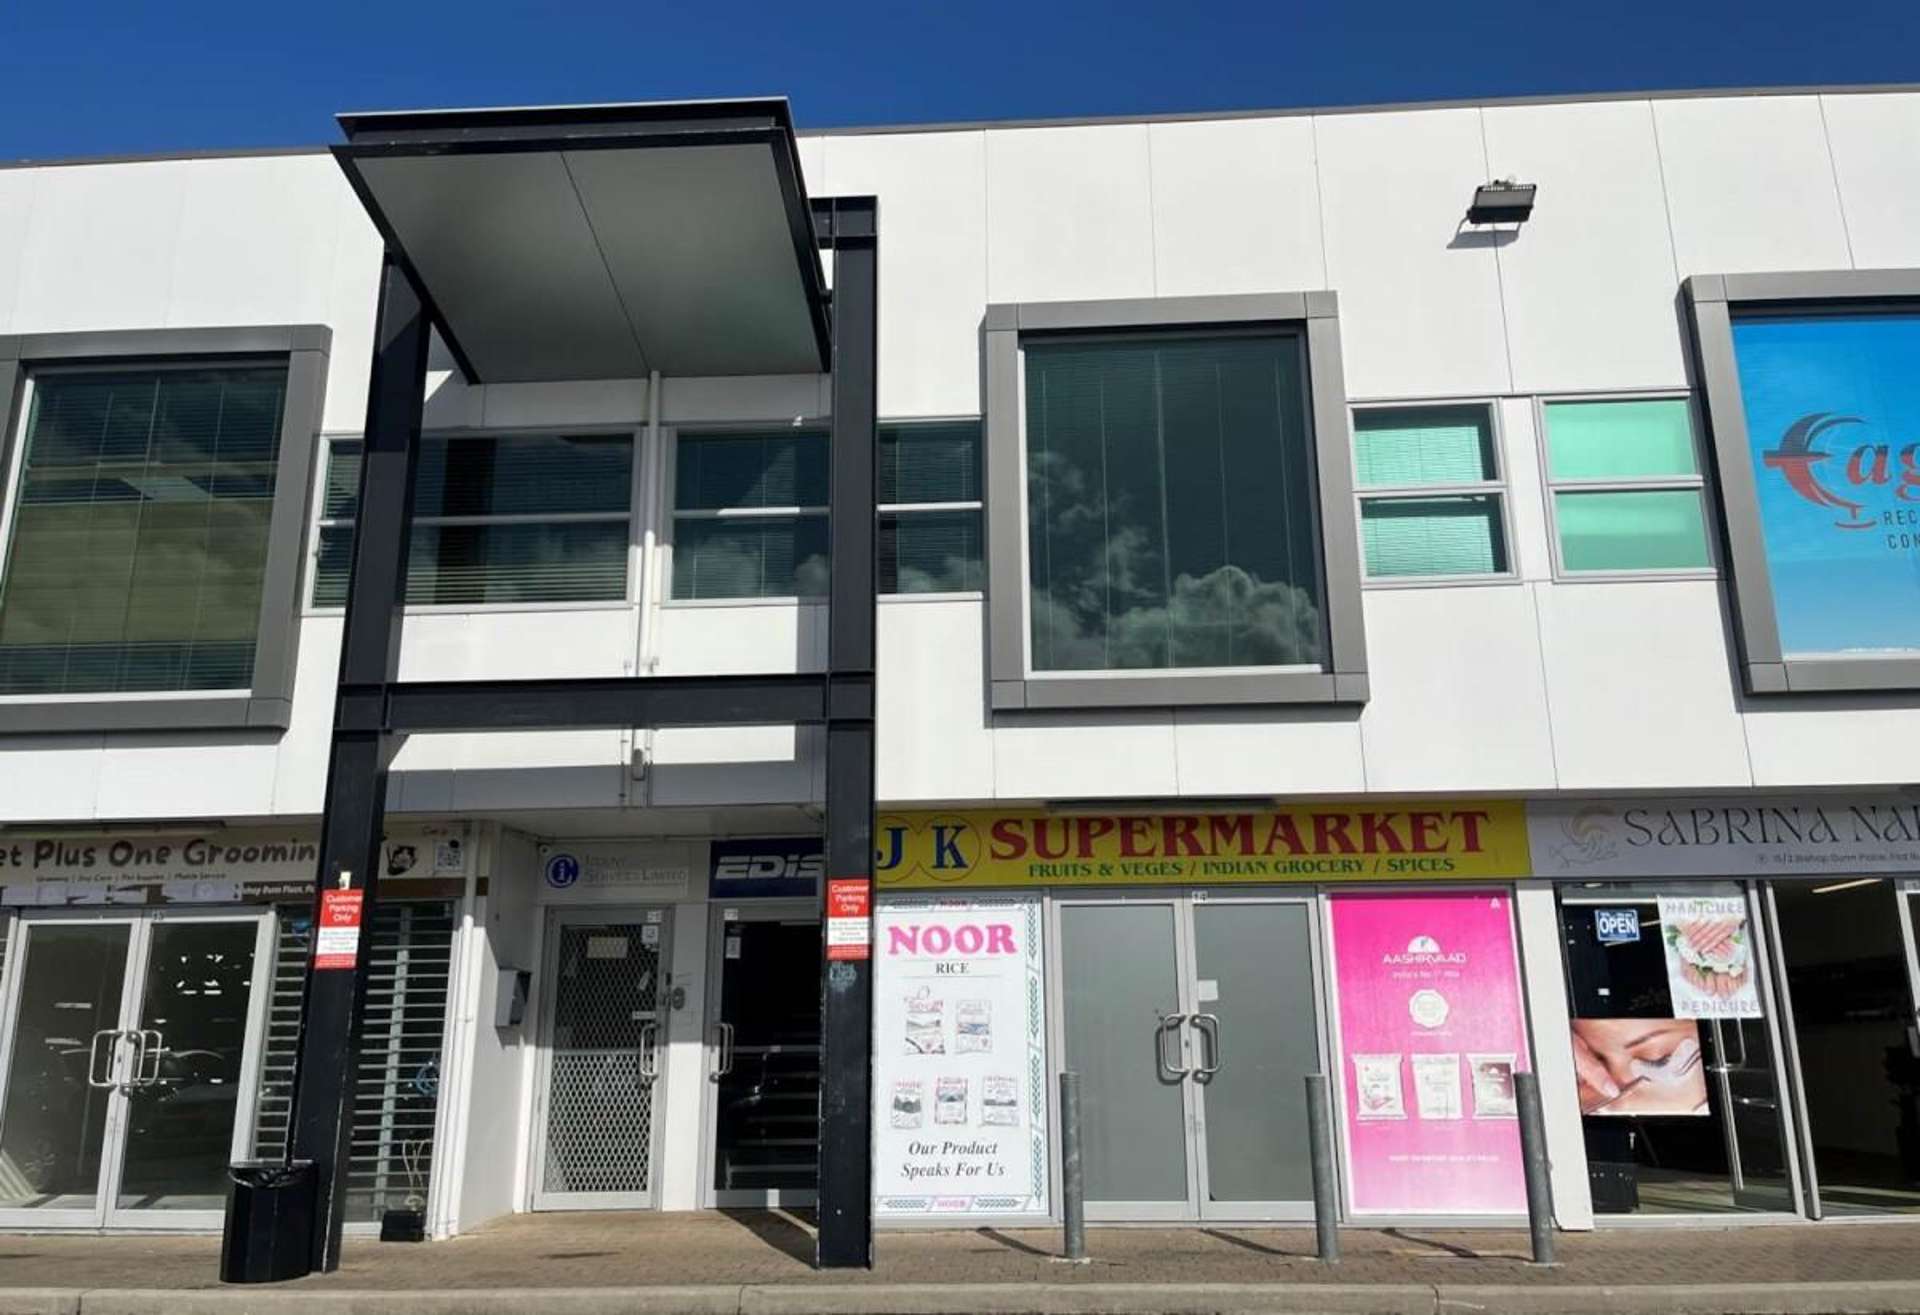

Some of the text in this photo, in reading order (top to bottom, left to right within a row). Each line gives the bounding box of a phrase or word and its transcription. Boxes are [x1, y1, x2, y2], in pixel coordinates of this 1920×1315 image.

[1624, 806, 1841, 847] SABRINA
[876, 810, 1491, 870] J K SUPERMARKET
[33, 839, 96, 869] Plus
[109, 840, 171, 867] One
[183, 837, 316, 866] Groomin
[1029, 863, 1092, 877] FRUITS
[1099, 863, 1113, 876] &
[1120, 861, 1182, 876] VEGES
[1203, 860, 1268, 874] INDIAN
[1274, 858, 1364, 874] GROCERY
[1386, 858, 1455, 873] SPICES
[840, 904, 860, 914] Only
[1600, 917, 1637, 934] OPEN
[887, 924, 1018, 955] NOOR
[936, 962, 970, 974] RICE
[1680, 1000, 1760, 1014] PEDICURE
[908, 1140, 999, 1155] Our Product
[901, 1162, 1006, 1180] Speaks For Us
